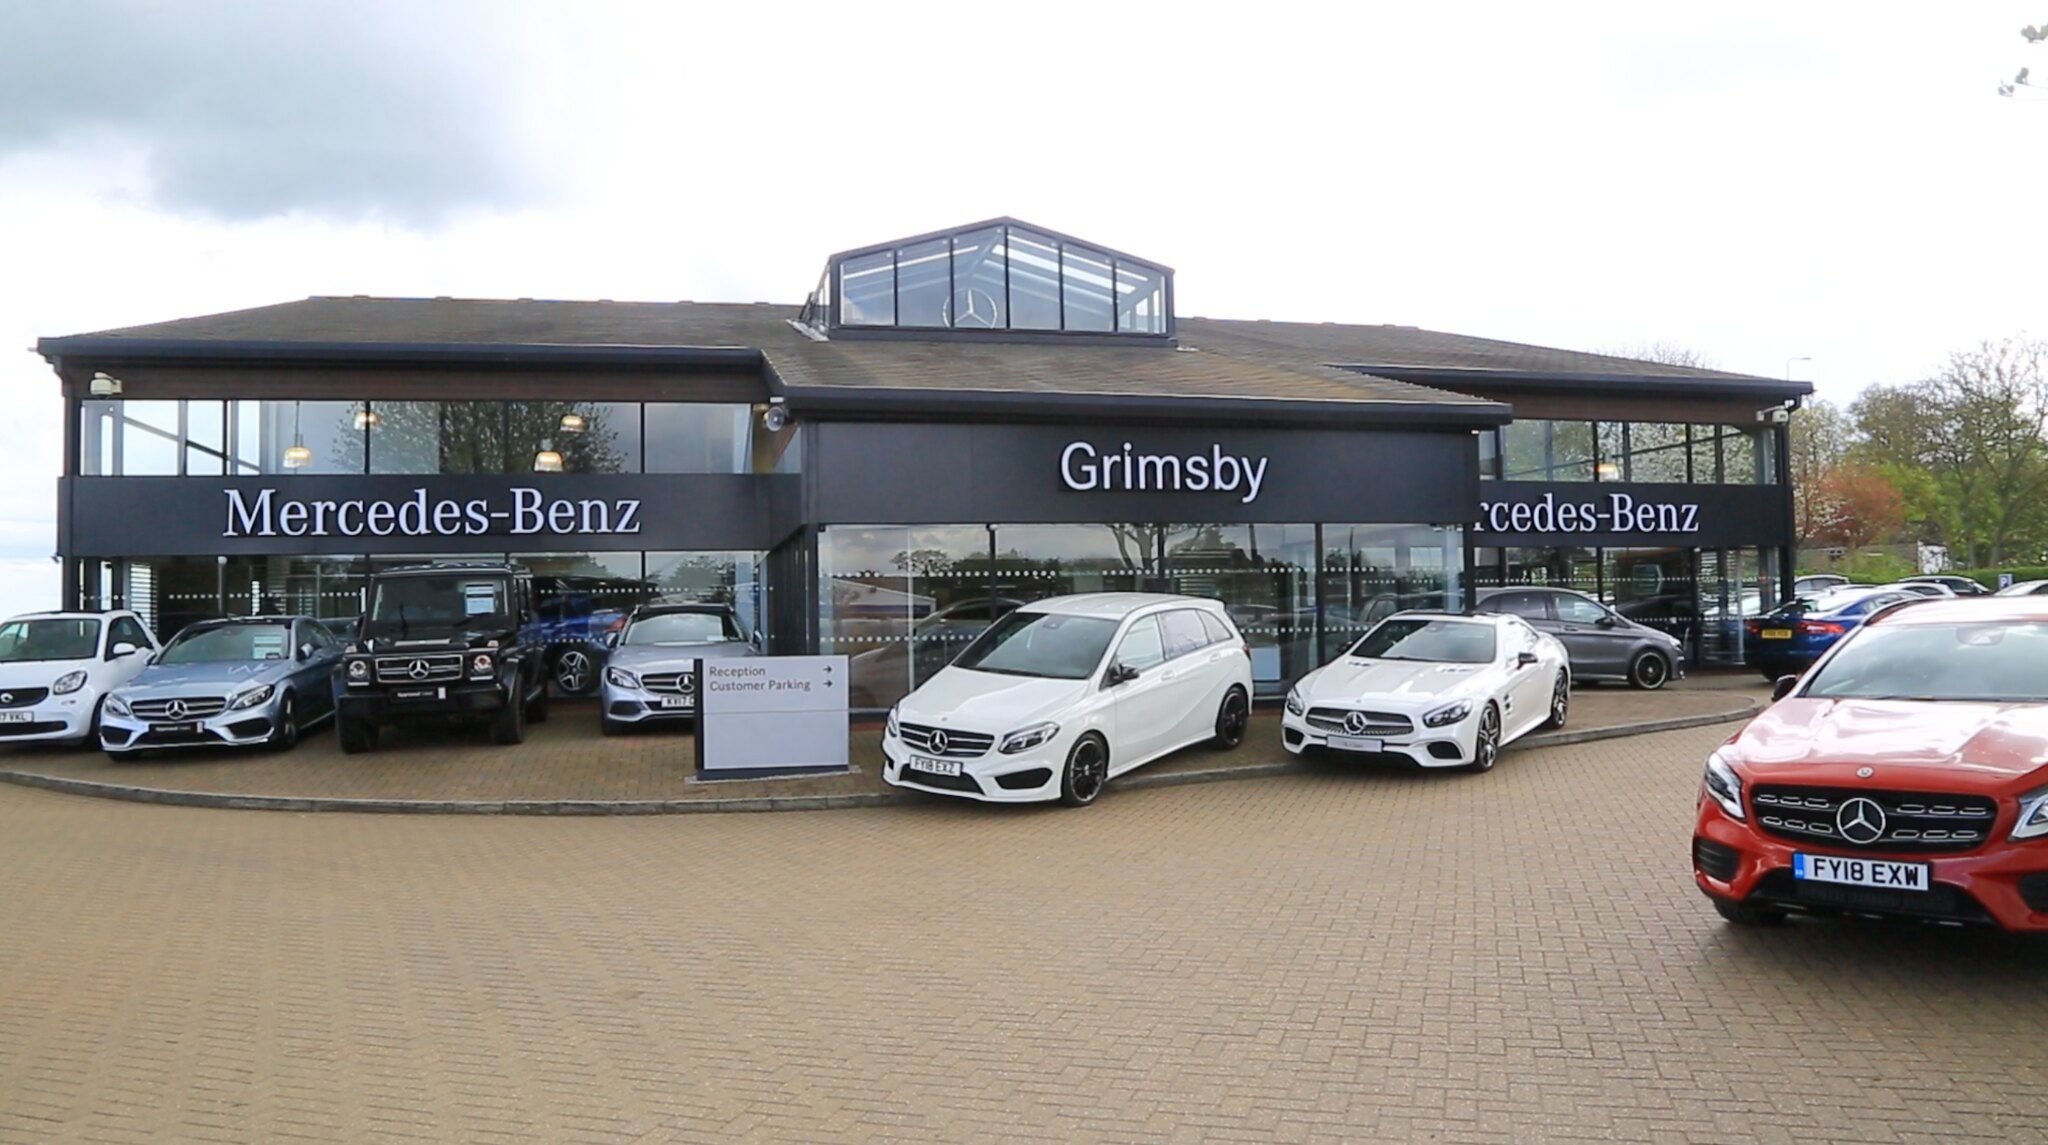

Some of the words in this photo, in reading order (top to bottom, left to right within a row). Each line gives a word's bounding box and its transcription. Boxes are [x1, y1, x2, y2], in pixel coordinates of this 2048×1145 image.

[1061, 441, 1268, 503] Grimsby
[222, 487, 641, 537] Mercedes-Benz
[1473, 492, 1700, 532] rcedes-Benz
[709, 666, 766, 677] Reception
[709, 680, 765, 691] Customer
[768, 679, 811, 691] Parking
[915, 756, 933, 771] FY18
[1813, 858, 1864, 881] FY18
[1871, 863, 1919, 887] EXW
